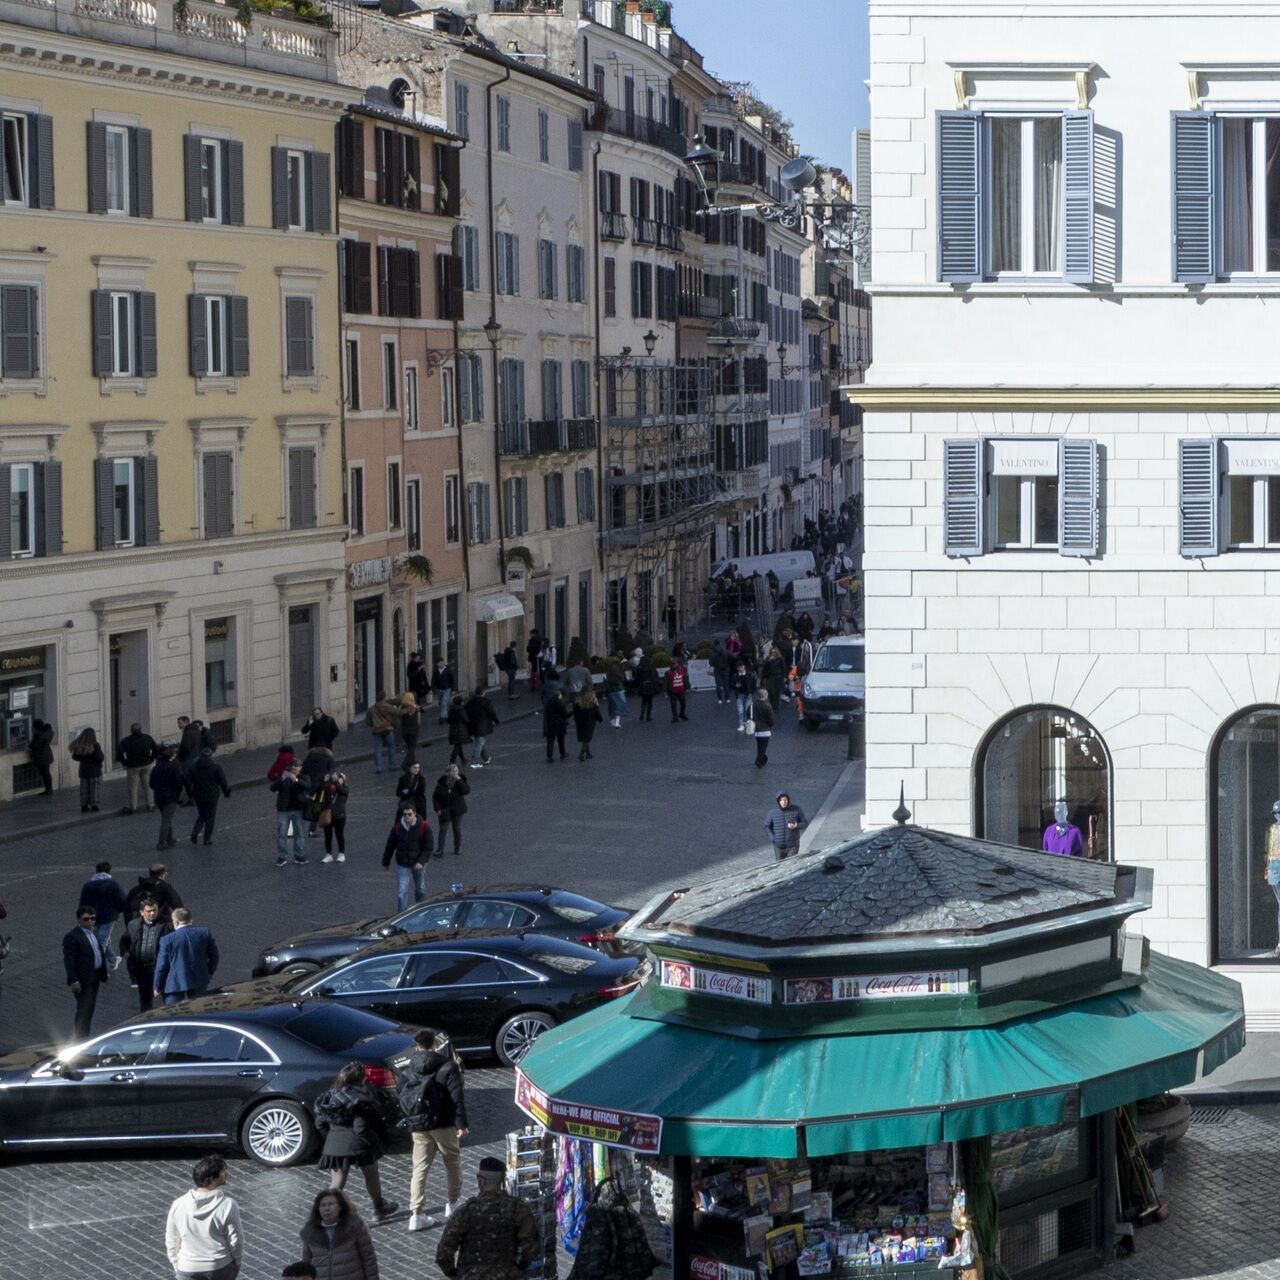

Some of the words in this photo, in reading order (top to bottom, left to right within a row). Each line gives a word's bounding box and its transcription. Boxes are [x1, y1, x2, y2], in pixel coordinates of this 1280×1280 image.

[1000, 458, 1049, 468] VALENTINO
[709, 973, 744, 995] Coca-Cola
[865, 974, 922, 995] Coca-Cola
[580, 1108, 593, 1120] ARE
[593, 1110, 620, 1126] OFFICIAL
